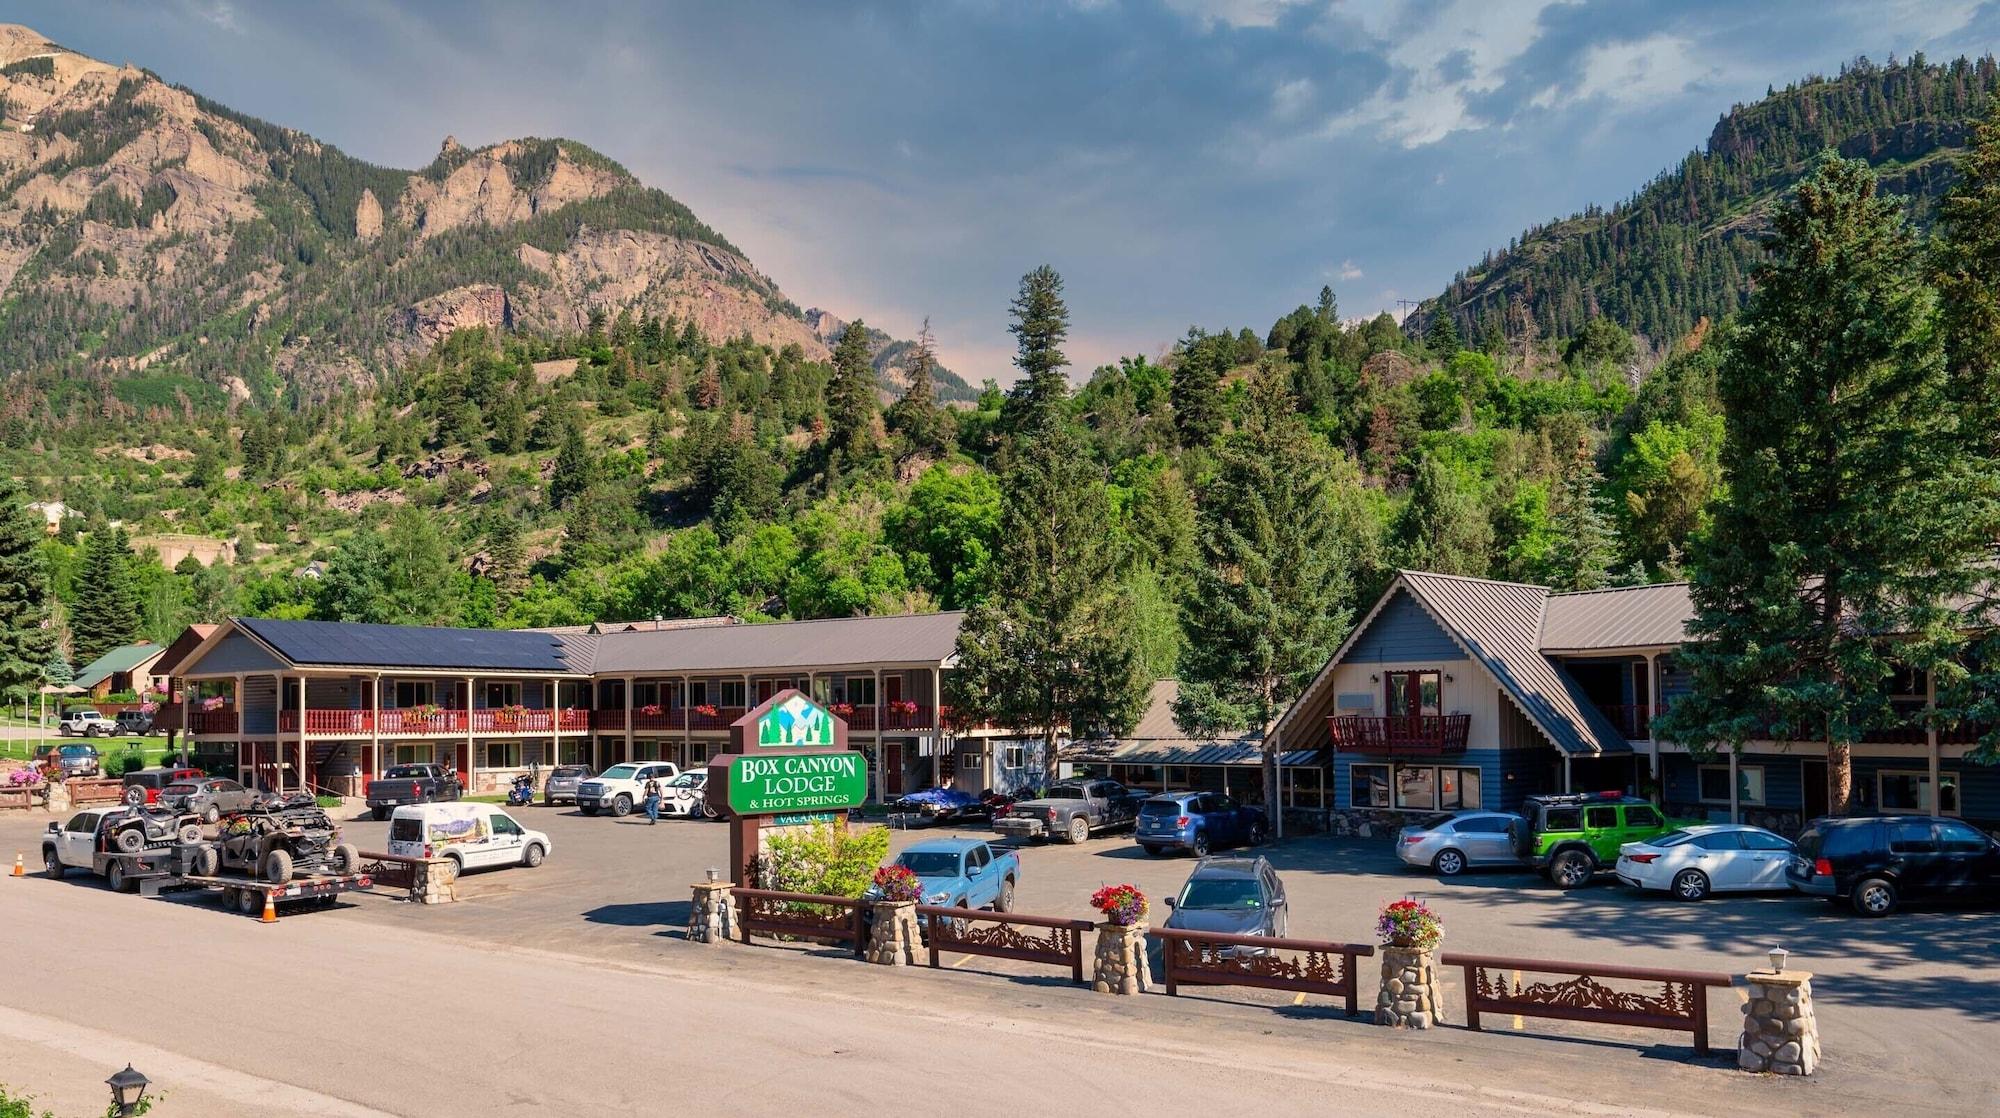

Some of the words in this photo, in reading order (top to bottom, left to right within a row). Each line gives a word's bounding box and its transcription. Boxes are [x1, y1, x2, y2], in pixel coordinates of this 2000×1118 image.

[741, 759, 779, 783] BOX
[784, 756, 856, 777] CANYON
[764, 776, 836, 795] LODGE
[749, 799, 759, 809] &
[762, 797, 794, 808] HOT
[796, 795, 849, 806] SPRINGS
[780, 813, 828, 823] VACANCY
